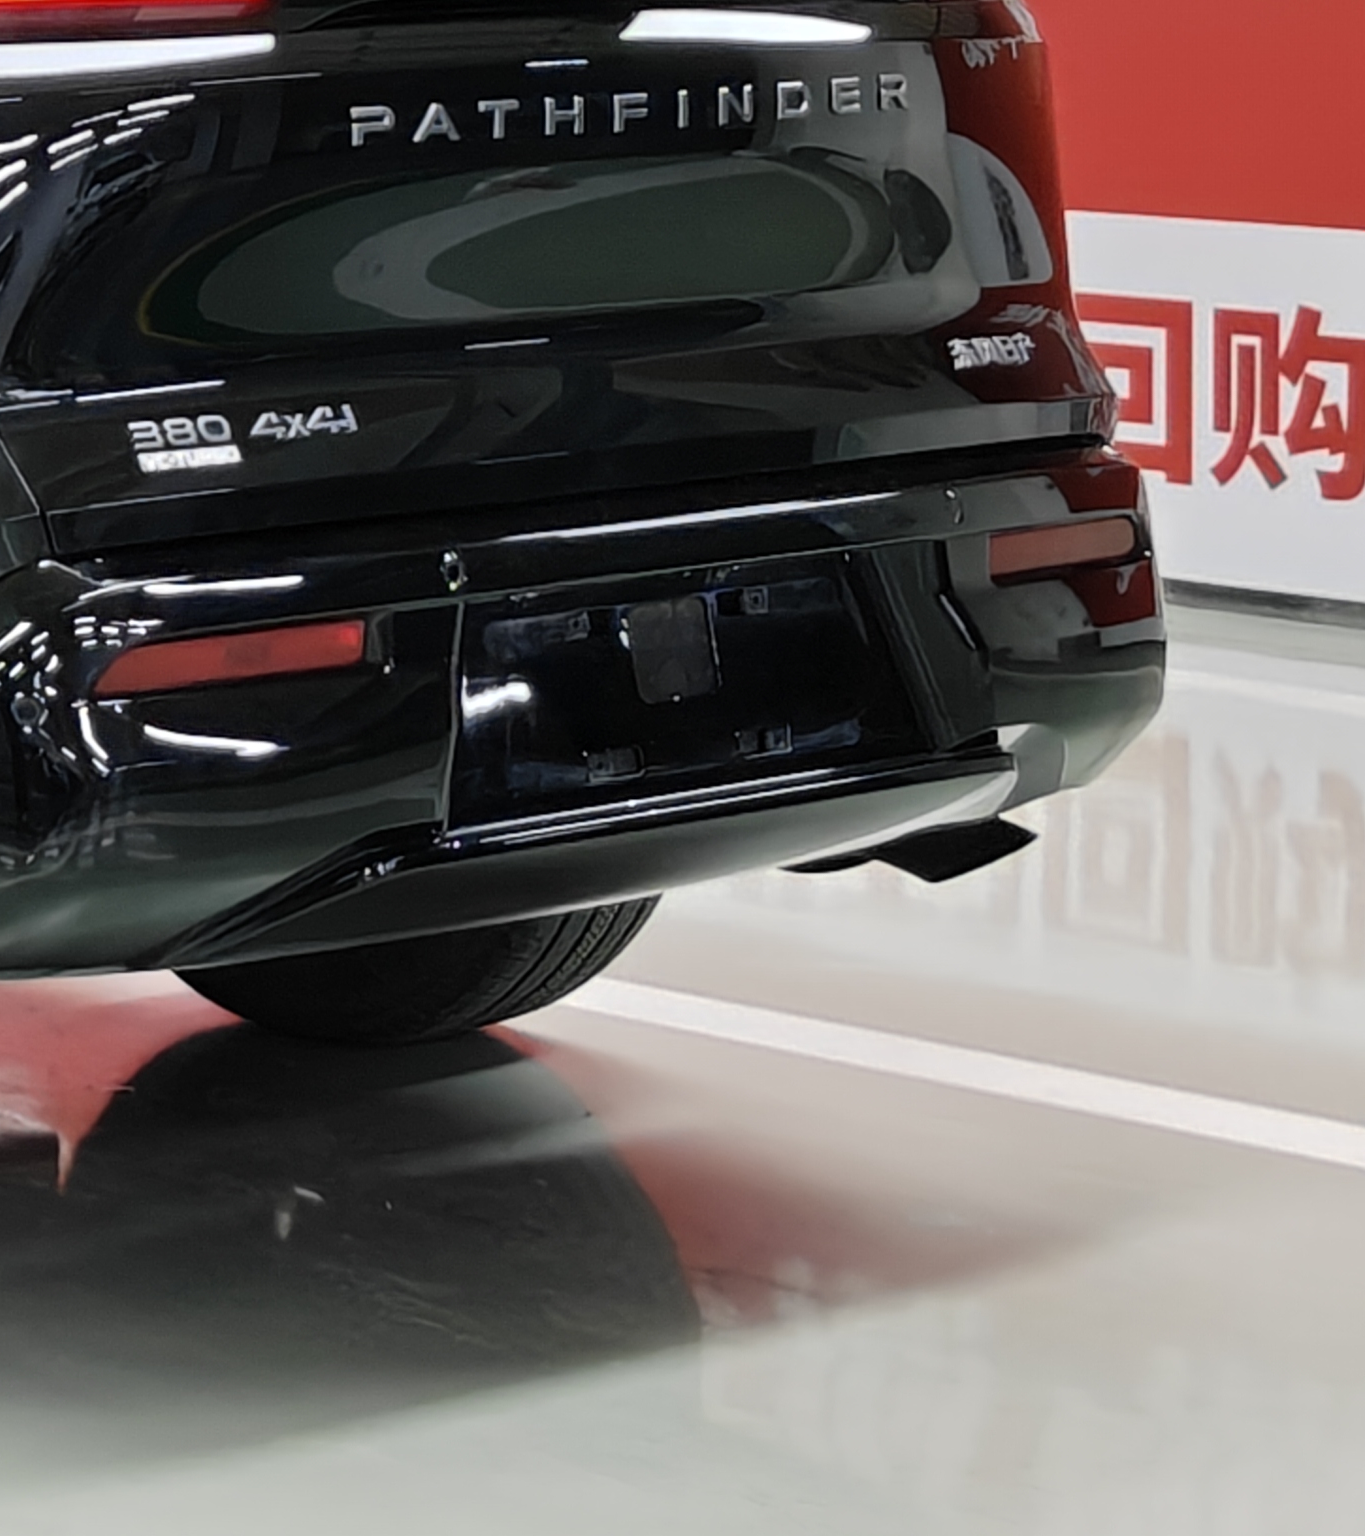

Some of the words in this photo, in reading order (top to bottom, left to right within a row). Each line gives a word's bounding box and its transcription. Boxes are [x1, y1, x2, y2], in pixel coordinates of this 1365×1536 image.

[349, 72, 910, 147] PATHFINDER
[127, 414, 233, 450] 380
[1073, 293, 1365, 501] 回购
